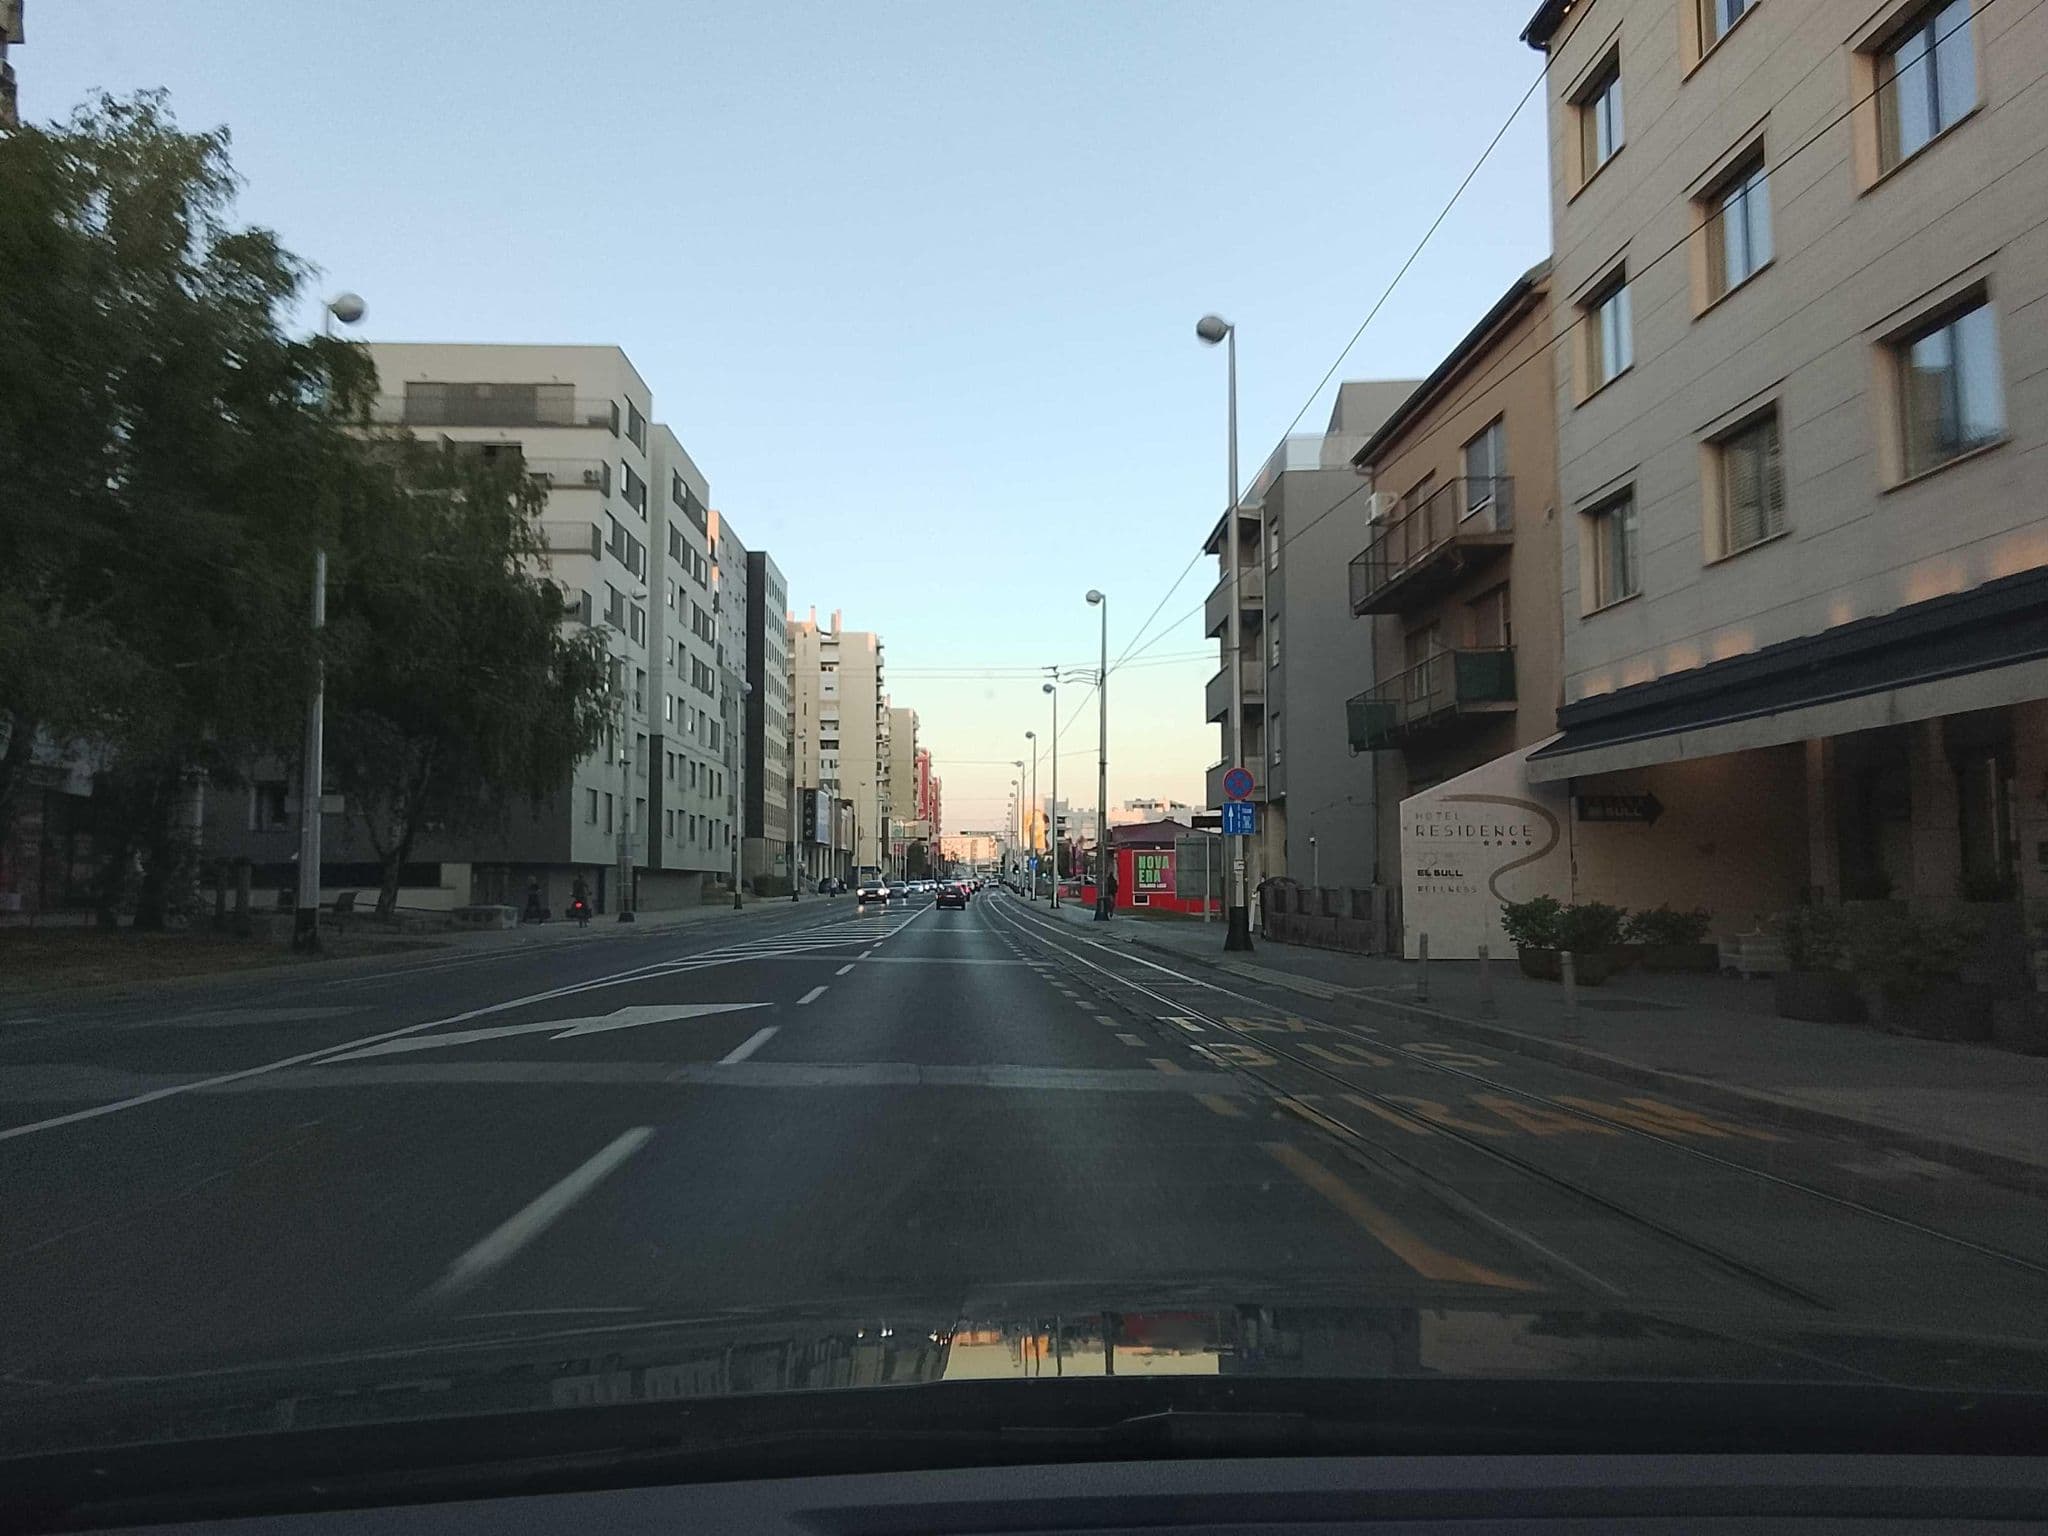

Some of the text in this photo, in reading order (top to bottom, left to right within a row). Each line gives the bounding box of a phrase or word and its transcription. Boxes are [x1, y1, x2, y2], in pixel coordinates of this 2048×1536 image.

[1415, 811, 1459, 821] HOTEL
[1416, 824, 1533, 837] RESIDENCE
[1138, 855, 1169, 869] NOVA
[1138, 869, 1161, 883] ERA
[1417, 869, 1463, 877] EL BULL
[1188, 1042, 1502, 1068] BUS
